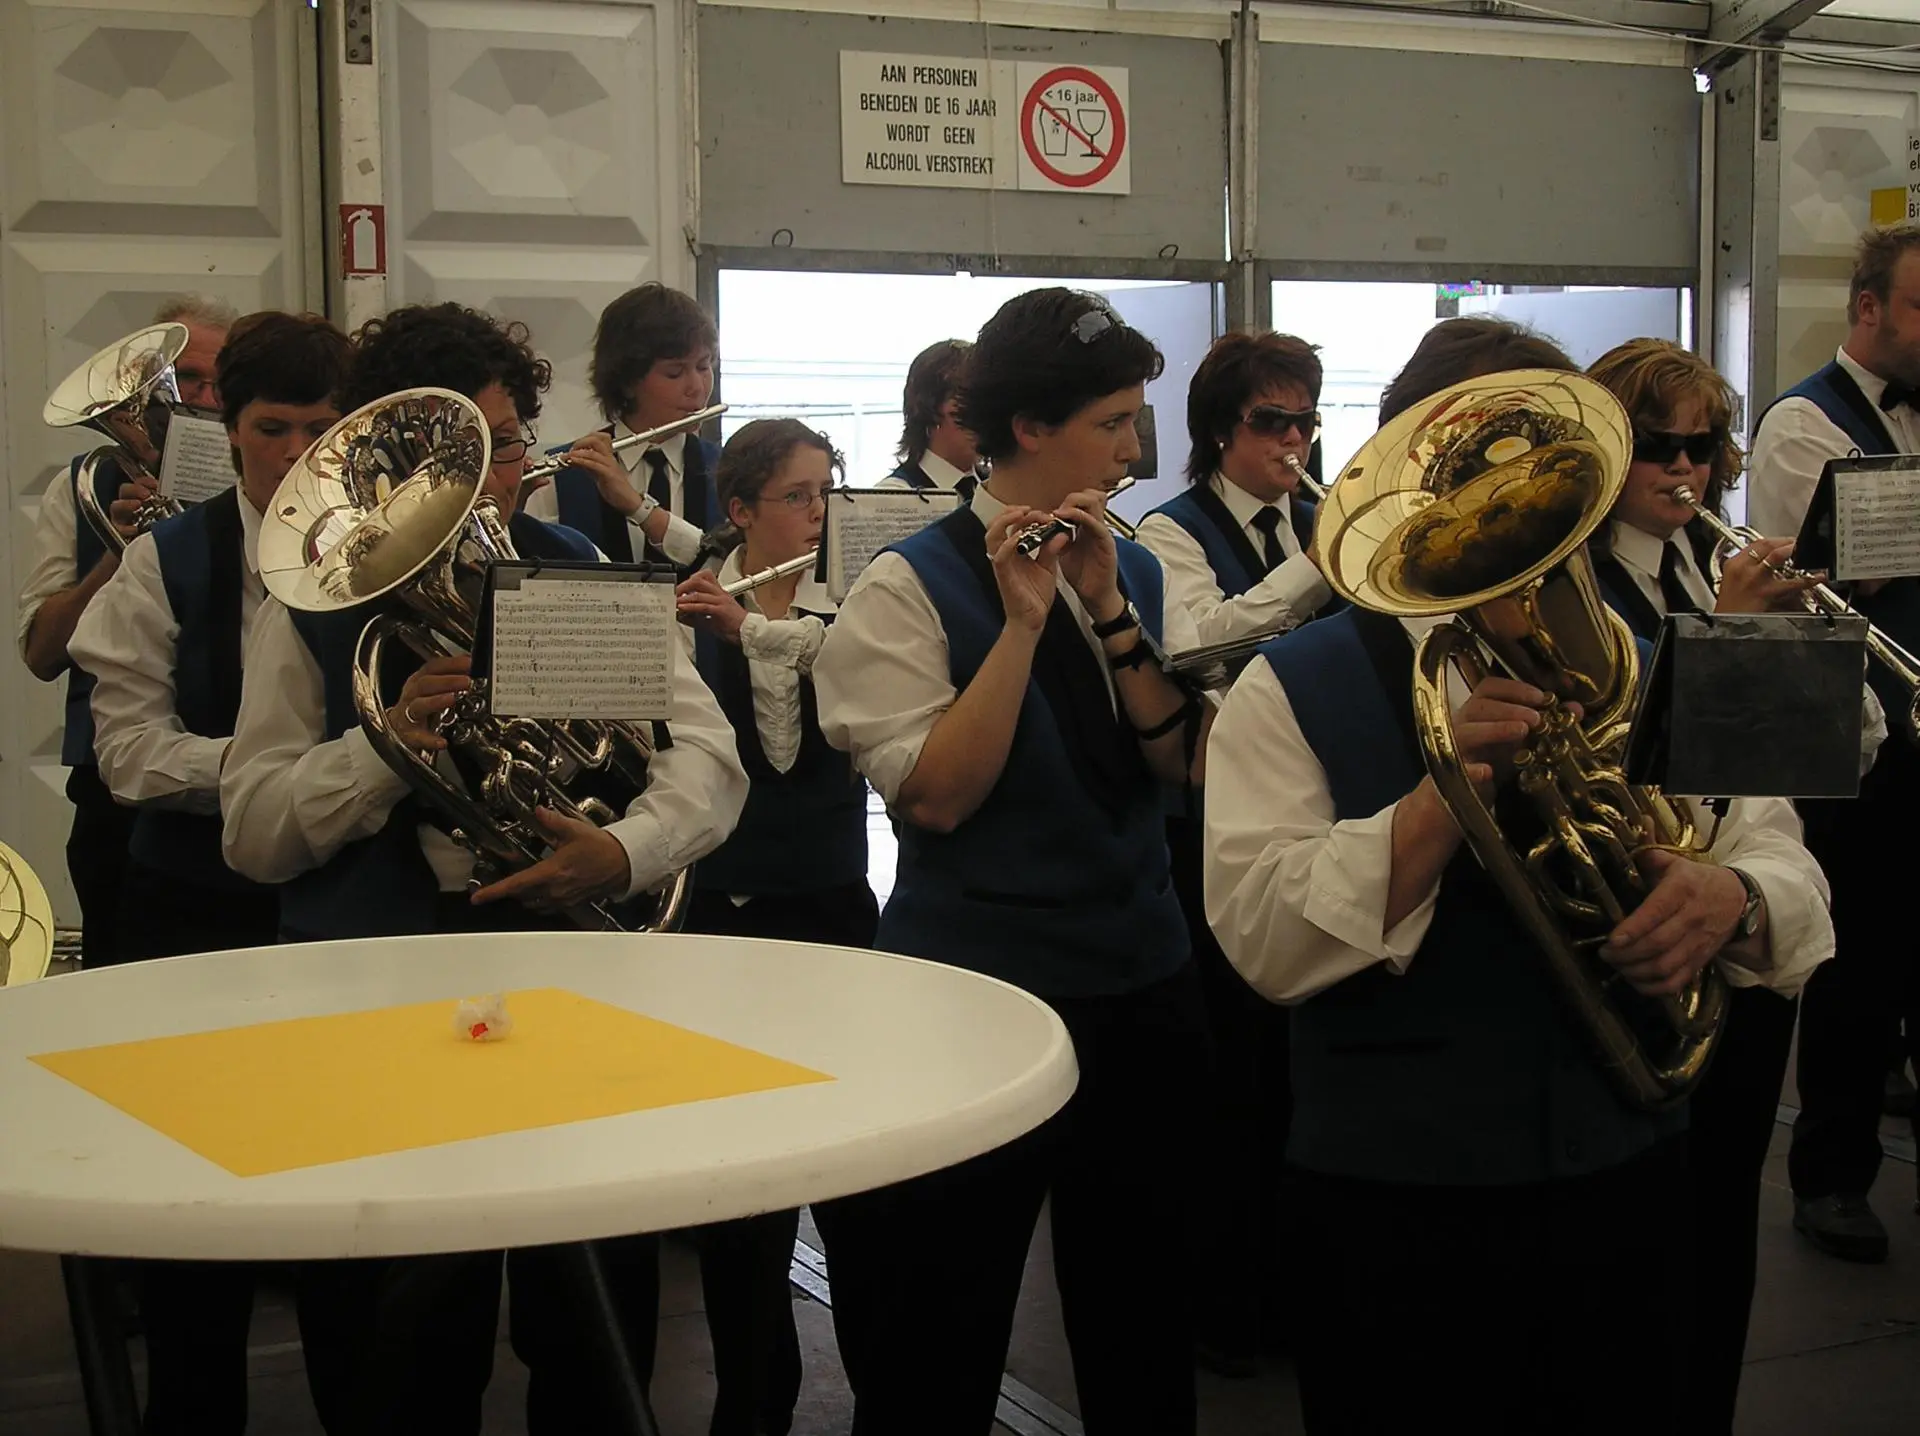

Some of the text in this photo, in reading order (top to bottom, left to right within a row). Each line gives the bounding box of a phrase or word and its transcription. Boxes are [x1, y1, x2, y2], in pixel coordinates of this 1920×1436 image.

[880, 64, 978, 88] AAN PERSONEN
[860, 92, 997, 117] BENEDEN DE 16 JAAR
[1057, 89, 1072, 103] 16
[1074, 90, 1099, 105] jaar
[886, 122, 976, 145] WORDT GEEN
[865, 151, 994, 176] ALCOHOL VERSTREKT
